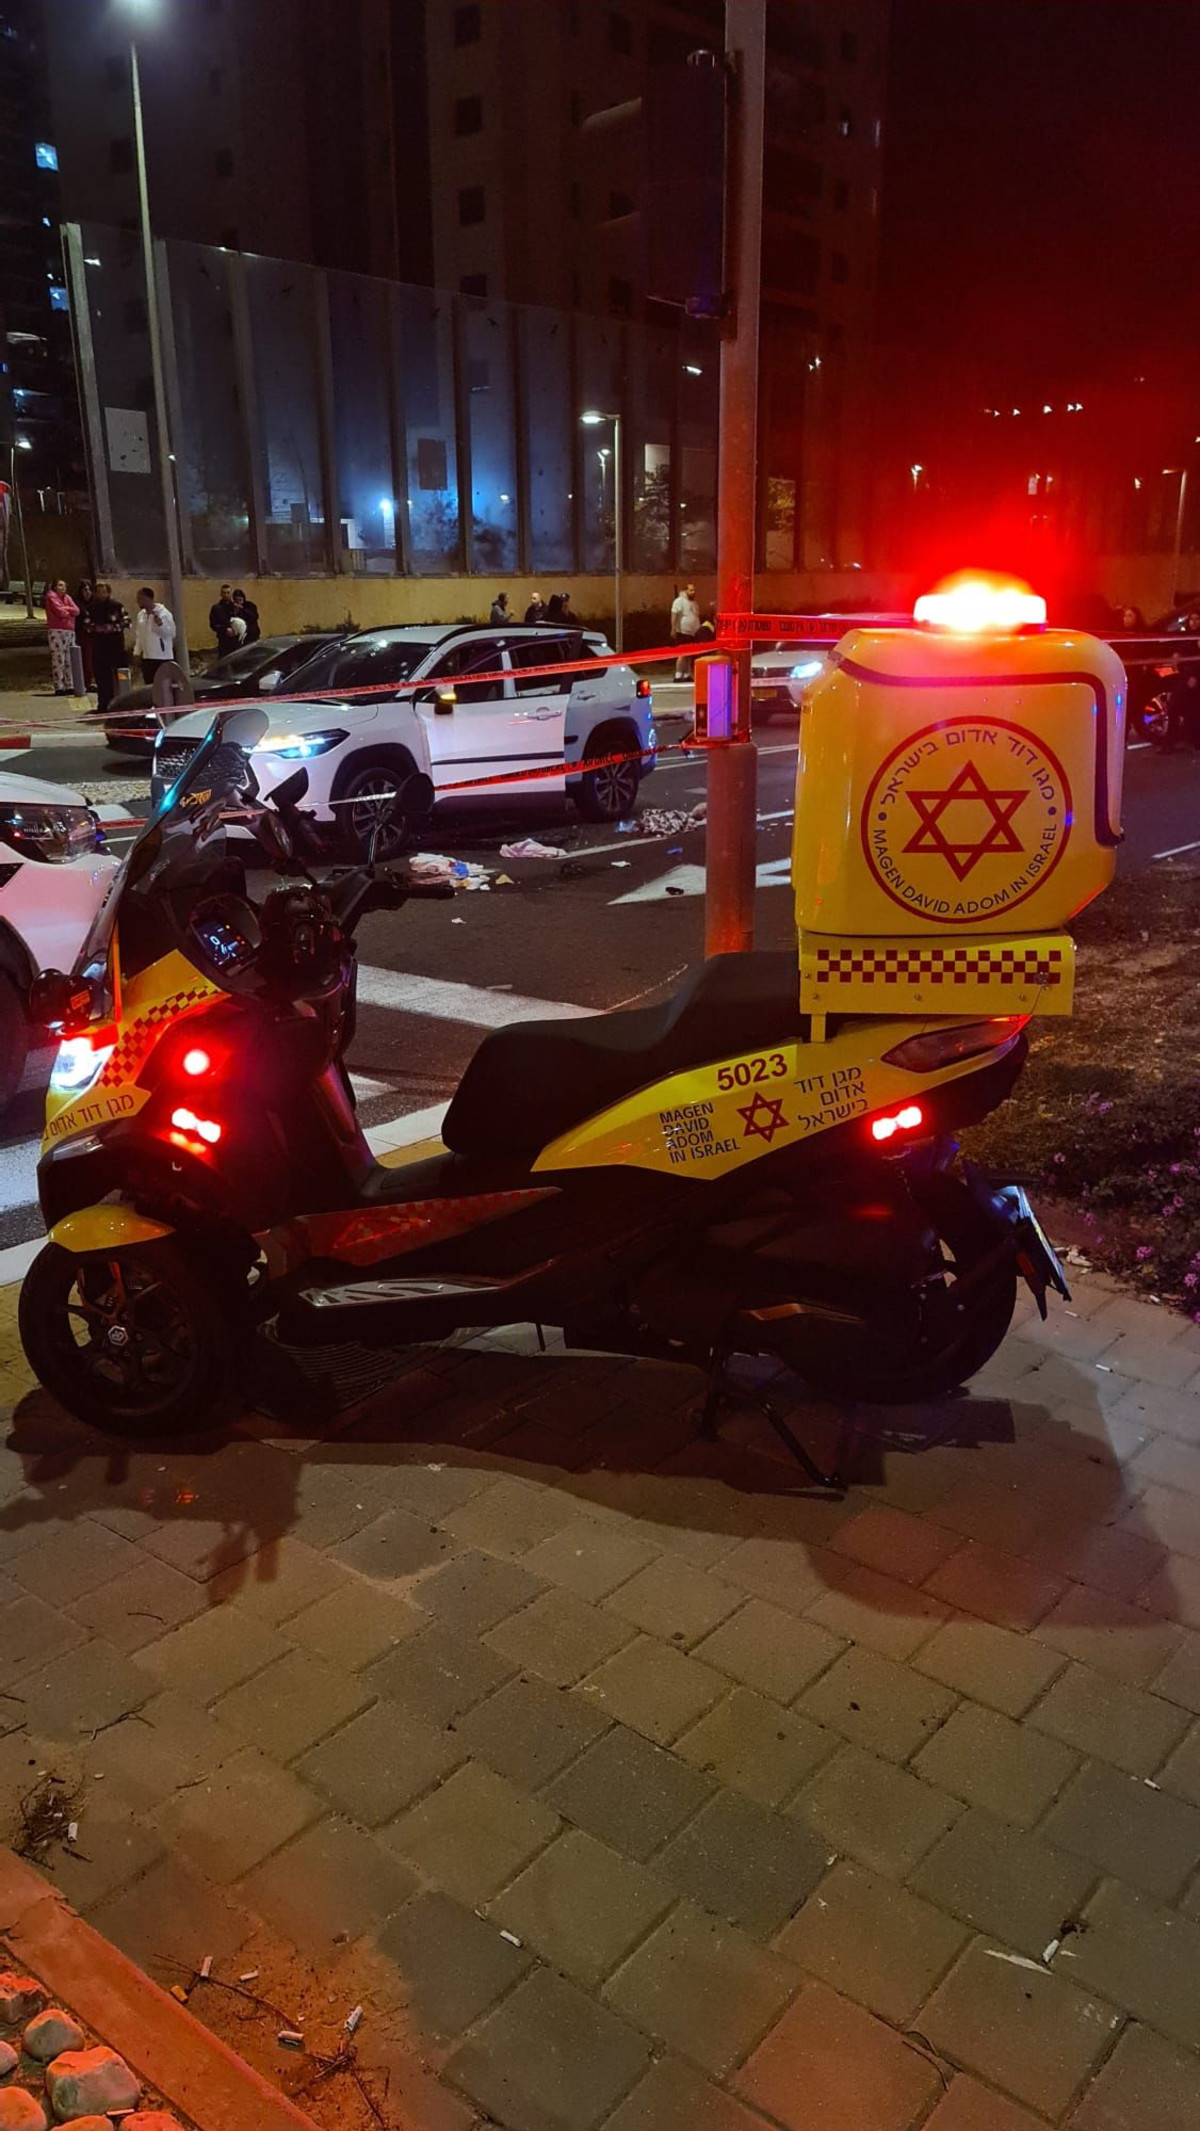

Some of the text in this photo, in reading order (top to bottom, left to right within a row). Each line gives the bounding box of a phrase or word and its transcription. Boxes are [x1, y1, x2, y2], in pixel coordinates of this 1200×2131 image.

[880, 729, 1055, 805] מגן דוד אדום בישראל
[873, 824, 1057, 914] MAGEN DAVID ADOM IN ISRAEL
[717, 1053, 788, 1091] 5023
[794, 1066, 862, 1094] מגן דוד
[106, 1094, 135, 1118] מגן
[820, 1081, 867, 1107] אדום
[49, 1112, 77, 1137] אדום
[77, 1103, 103, 1123] דוד
[659, 1102, 714, 1124] MAGEN
[797, 1098, 869, 1131] בישראל
[662, 1117, 710, 1138] DAVID
[666, 1130, 714, 1151] ADOM
[669, 1138, 741, 1164] IN ISRAEL
